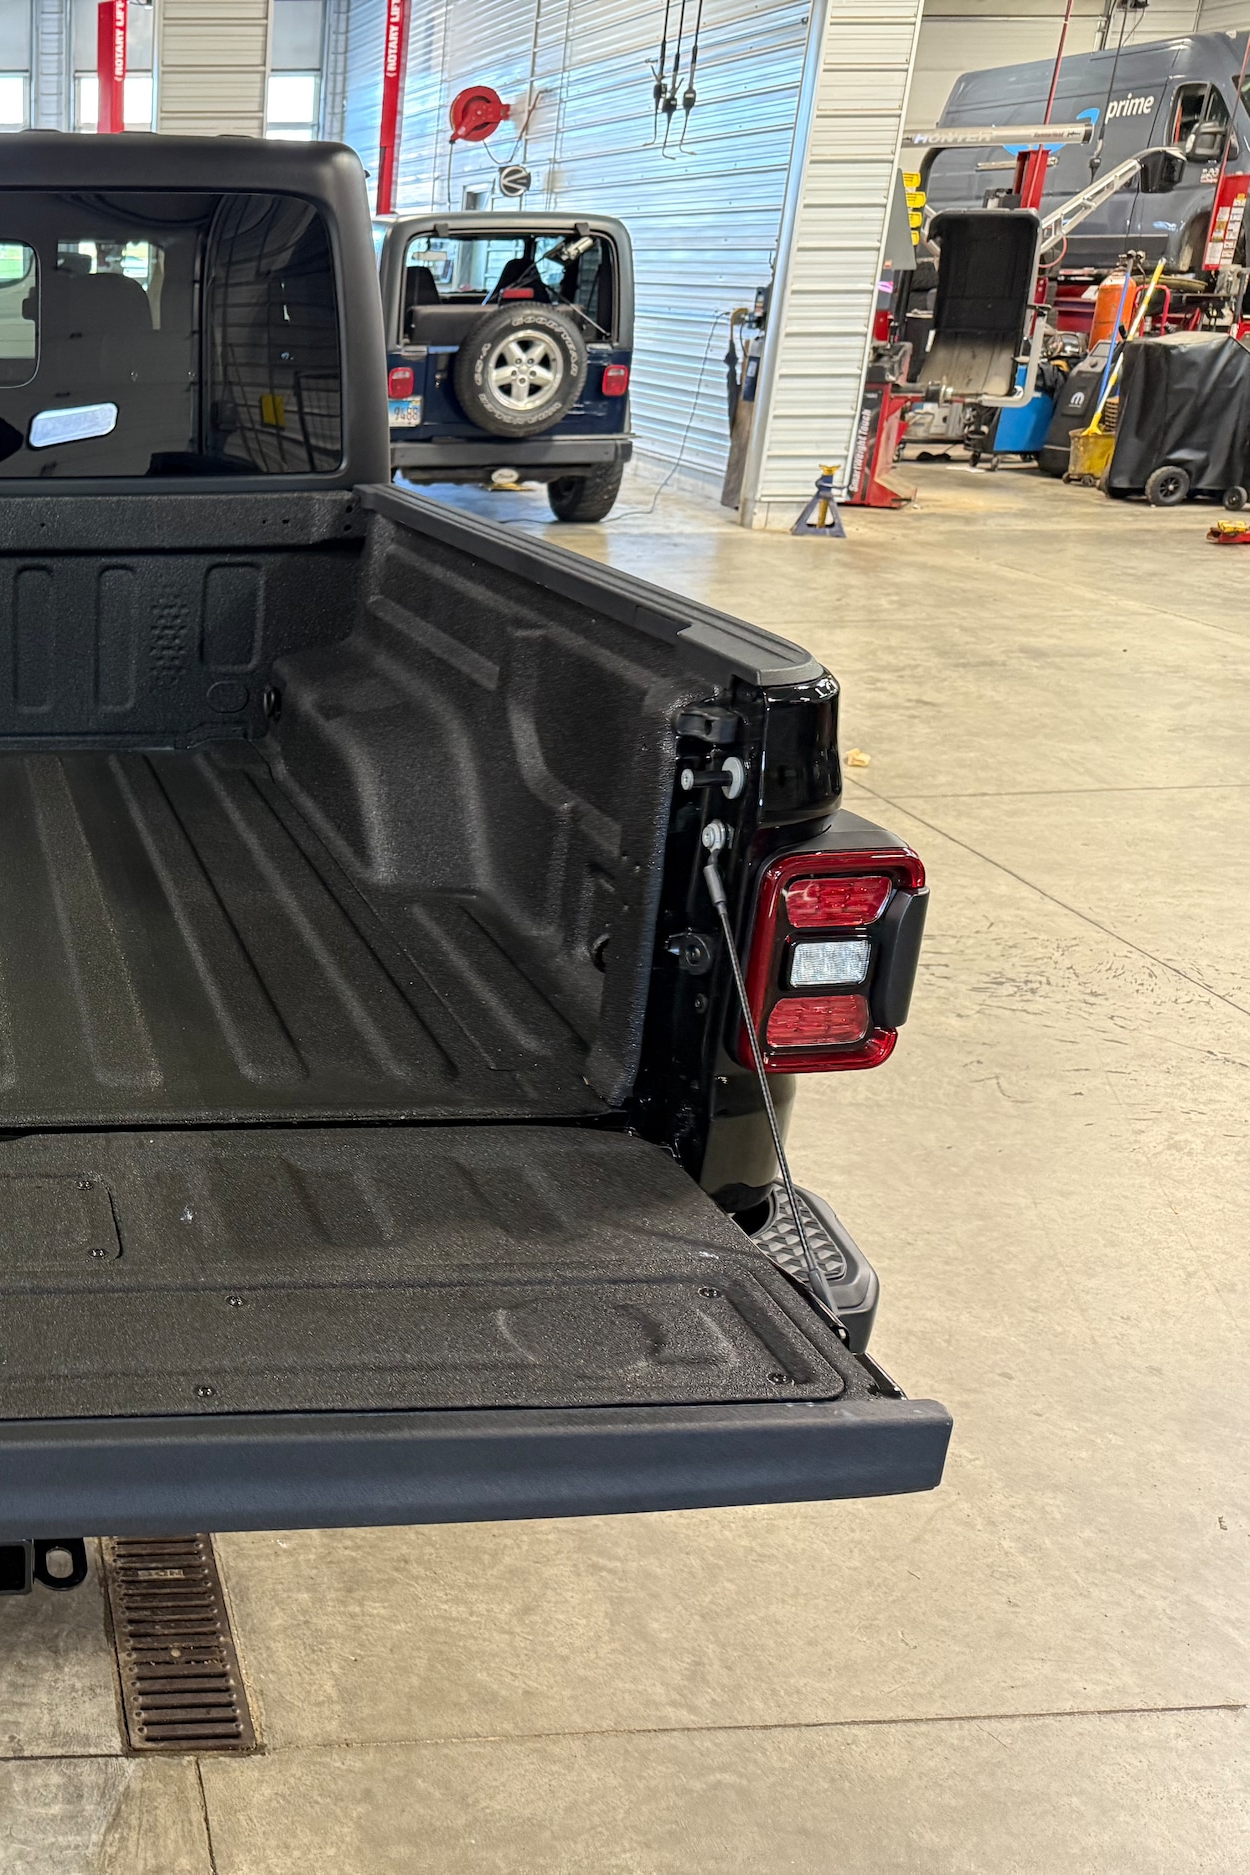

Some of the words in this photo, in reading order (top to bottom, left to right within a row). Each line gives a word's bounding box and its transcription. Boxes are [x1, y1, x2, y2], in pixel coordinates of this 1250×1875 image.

[115, 0, 125, 27] LIFT
[114, 28, 124, 76] ROTARY
[387, 25, 399, 72] ROTARY
[1105, 92, 1155, 124] prime
[512, 316, 578, 377] GOODYEAR
[478, 393, 562, 425] WRANGLER
[858, 409, 871, 436] Touch
